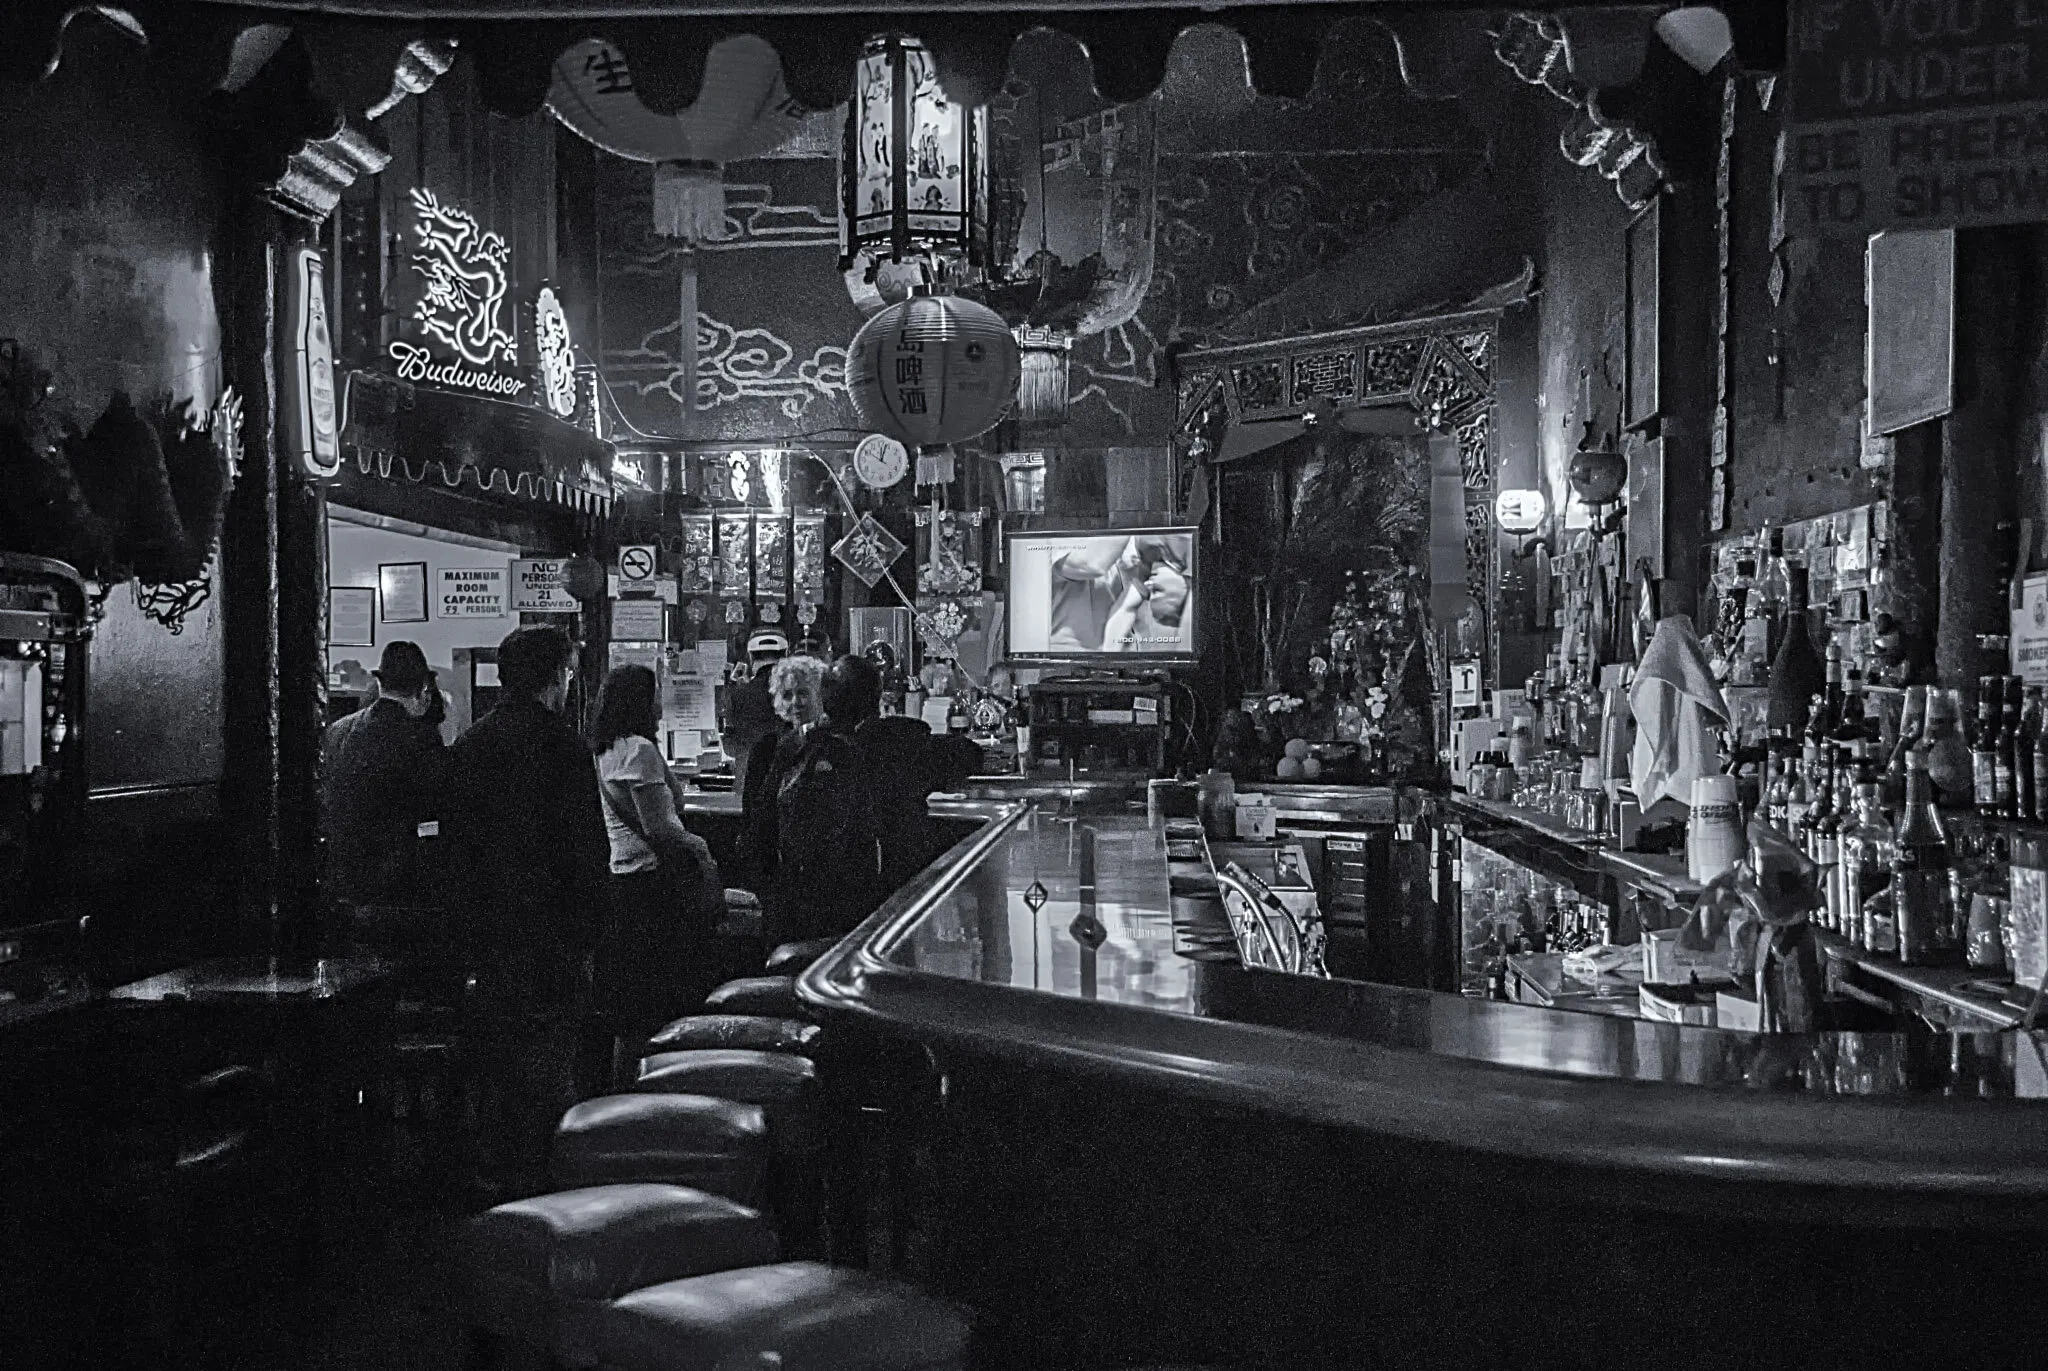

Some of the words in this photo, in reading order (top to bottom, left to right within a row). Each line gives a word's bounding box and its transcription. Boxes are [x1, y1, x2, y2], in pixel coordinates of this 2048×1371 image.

[1839, 43, 2031, 108] UNDER
[1801, 131, 1860, 176] BE
[1801, 182, 1866, 222] TO
[389, 341, 526, 396] Budweiser
[532, 562, 559, 573] NO
[444, 571, 500, 581] MAXIMUM
[456, 583, 488, 593] ROOM
[443, 595, 500, 605] CAPACITY
[538, 590, 552, 600] 21
[517, 600, 573, 608] ALLOWED
[465, 605, 502, 614] PERSONS
